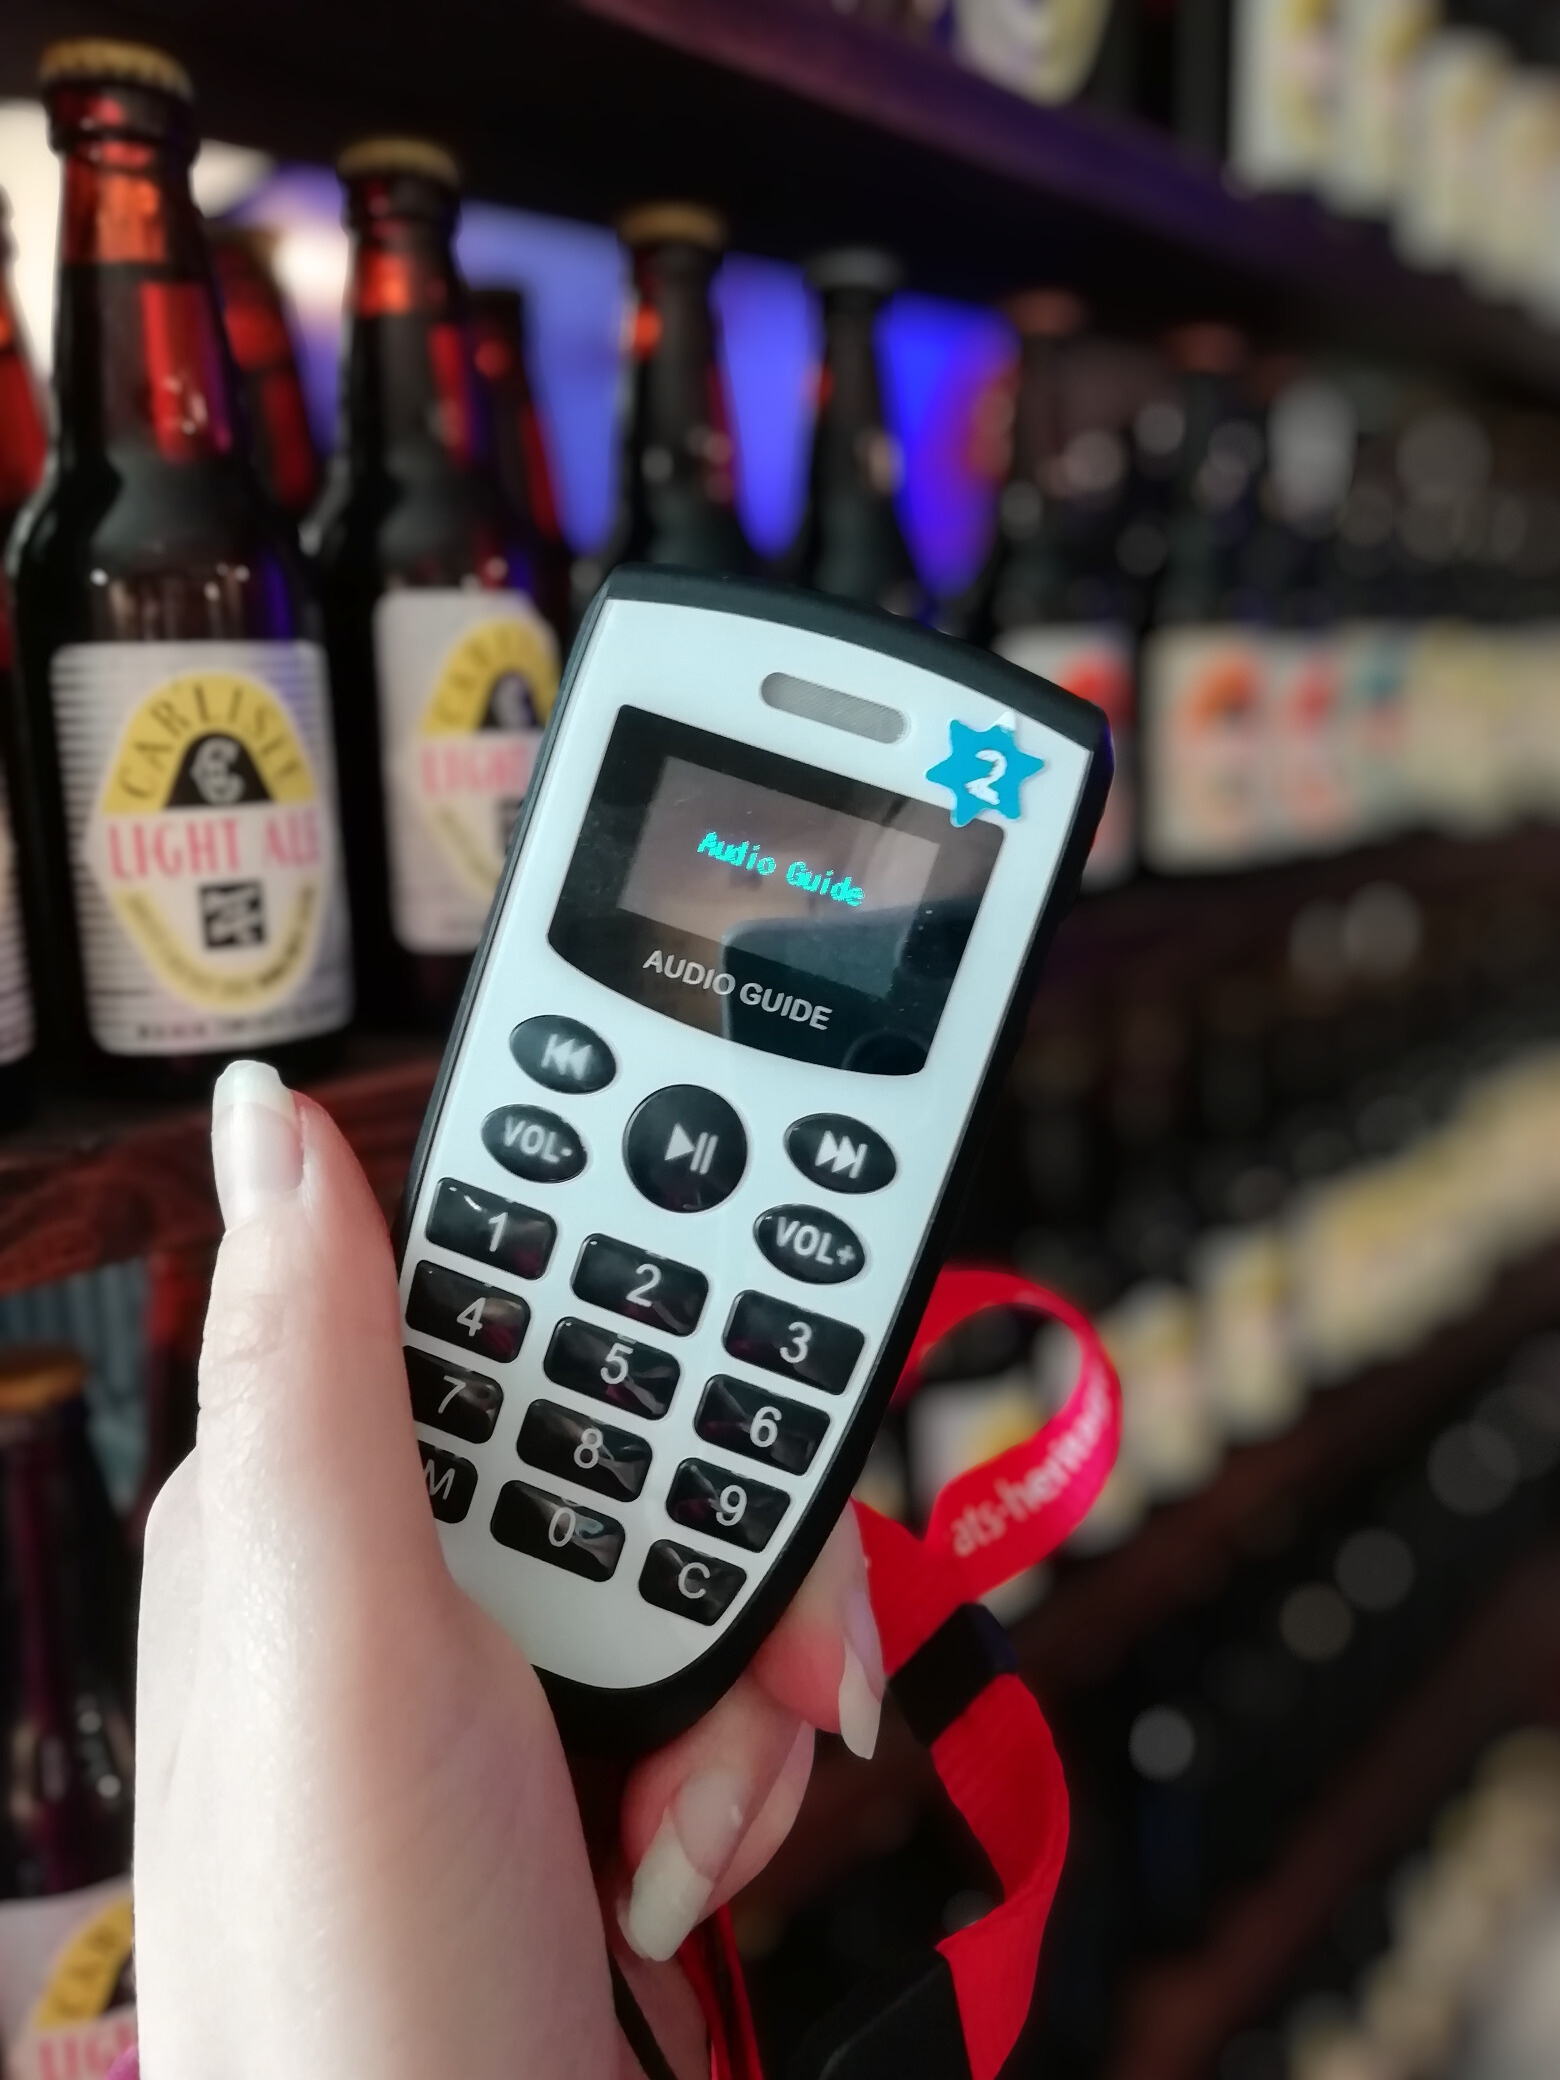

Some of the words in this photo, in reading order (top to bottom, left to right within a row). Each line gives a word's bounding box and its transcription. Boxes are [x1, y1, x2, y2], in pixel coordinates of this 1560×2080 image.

[964, 748, 1008, 806] 2
[108, 817, 241, 881] LIGHT
[697, 831, 776, 876] Audio
[785, 861, 866, 907] Guide
[642, 949, 736, 996] AUDIO
[739, 981, 834, 1032] GUIDE
[501, 1115, 574, 1165] VOL-
[487, 1211, 510, 1253] 1
[774, 1215, 857, 1266] VOL+
[625, 1262, 663, 1308] 2
[456, 1295, 488, 1338] 4
[600, 1341, 634, 1386] 5
[779, 1320, 814, 1364] 3
[436, 1374, 468, 1415] 7
[572, 1426, 604, 1470] 8
[748, 1404, 783, 1449] 6
[424, 1458, 456, 1501] M
[546, 1505, 577, 1549] 0
[714, 1484, 749, 1528] 9
[676, 1560, 712, 1600] C
